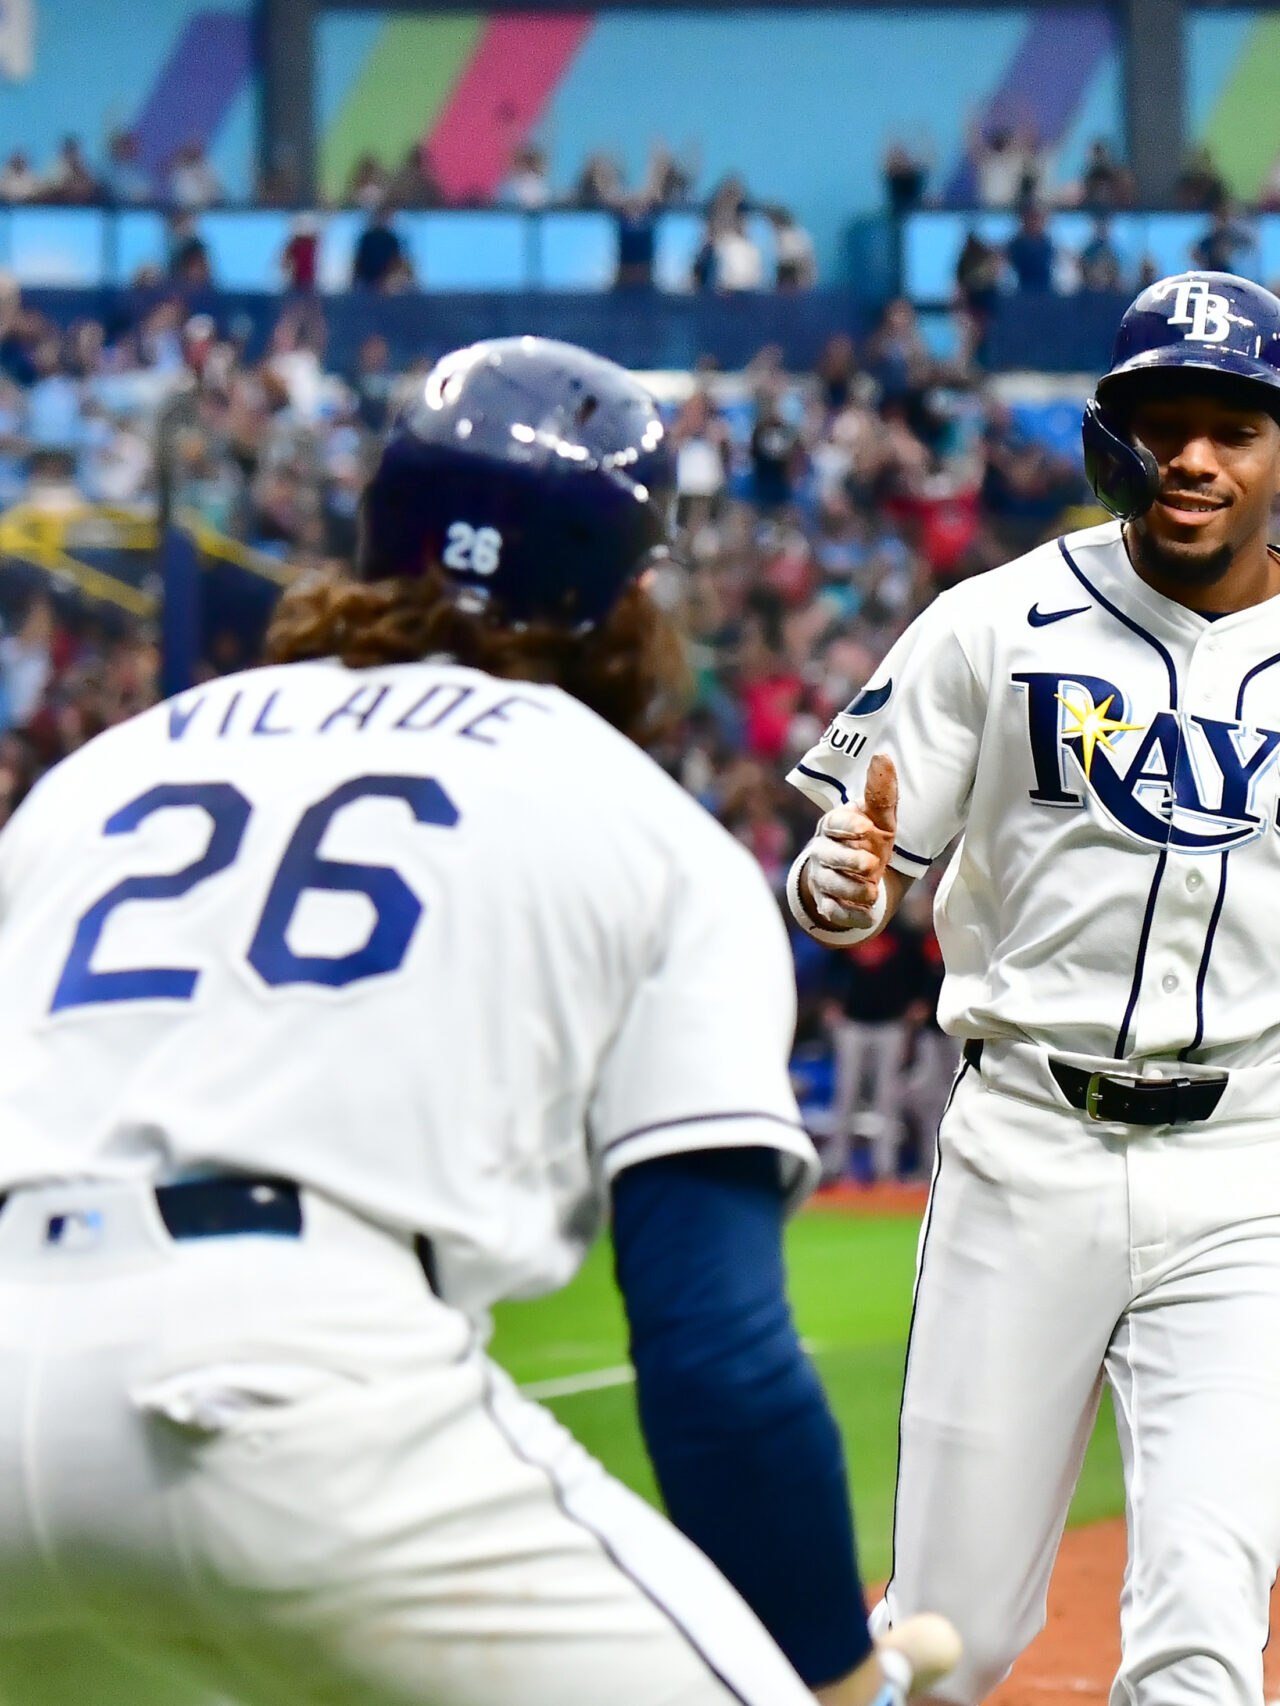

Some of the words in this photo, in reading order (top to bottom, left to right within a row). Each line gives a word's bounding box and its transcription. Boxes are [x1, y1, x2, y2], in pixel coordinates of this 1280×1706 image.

[1152, 280, 1230, 342] TB
[443, 520, 503, 575] 26
[167, 683, 554, 745] VILADE
[50, 774, 460, 1014] 26
